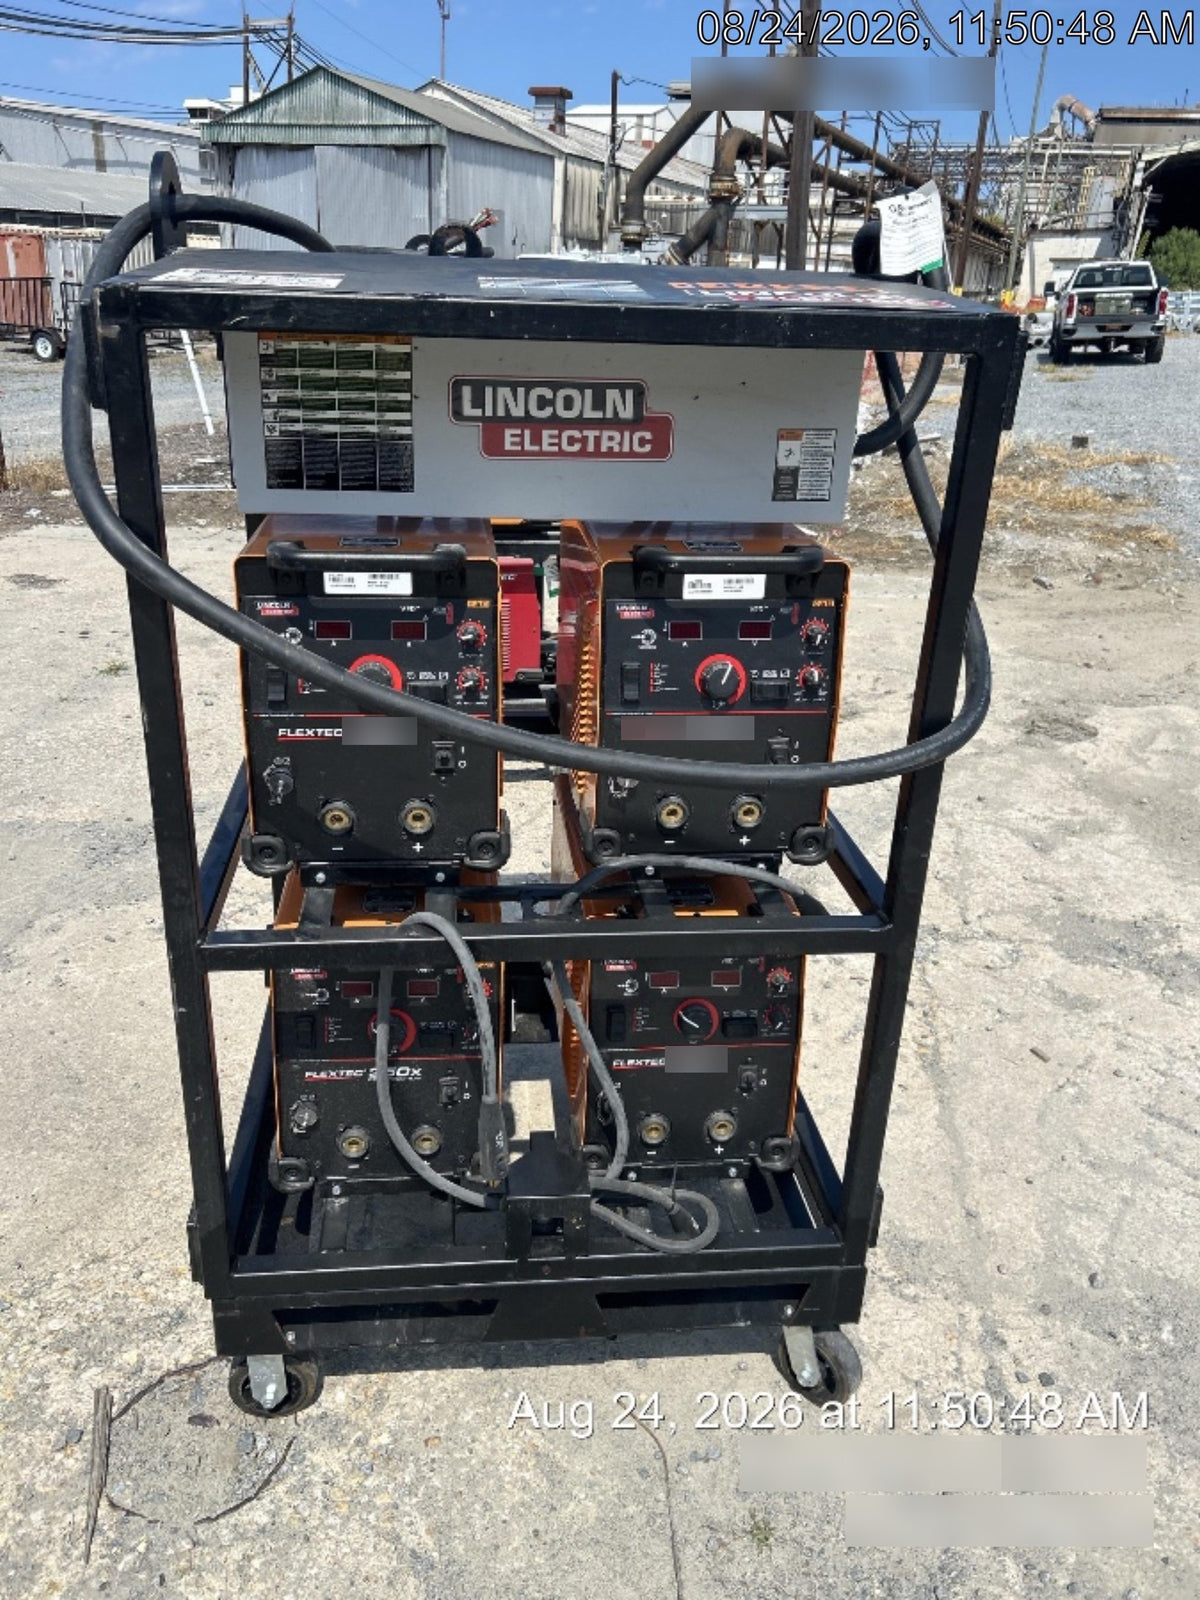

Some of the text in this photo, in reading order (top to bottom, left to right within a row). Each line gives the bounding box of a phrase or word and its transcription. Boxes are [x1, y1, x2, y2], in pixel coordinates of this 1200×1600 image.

[460, 385, 634, 419] LINCOLN
[503, 428, 653, 453] ELECTRIC
[277, 728, 342, 738] FLEXTEC
[304, 1069, 364, 1079] FLEXTEC
